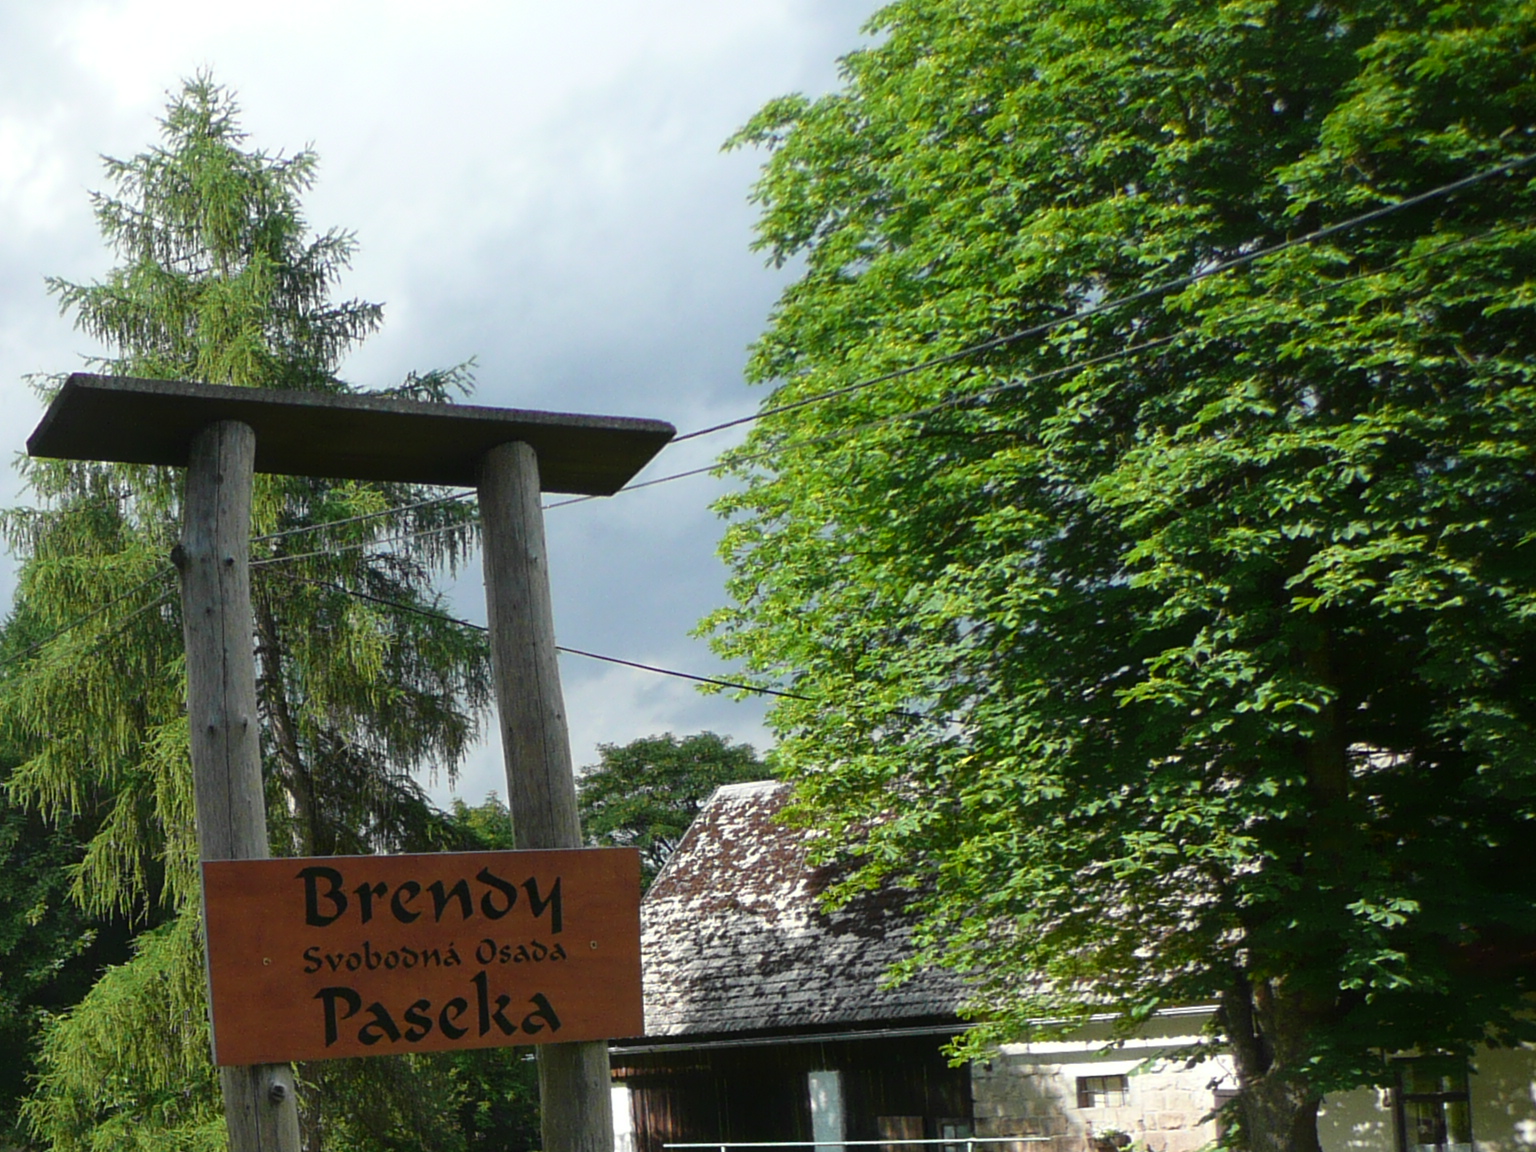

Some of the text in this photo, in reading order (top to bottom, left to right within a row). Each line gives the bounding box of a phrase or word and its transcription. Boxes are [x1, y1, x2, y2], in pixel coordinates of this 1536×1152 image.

[294, 865, 563, 935] Brendy
[302, 938, 567, 975] Svobodná Osada
[312, 970, 562, 1048] Paseka
